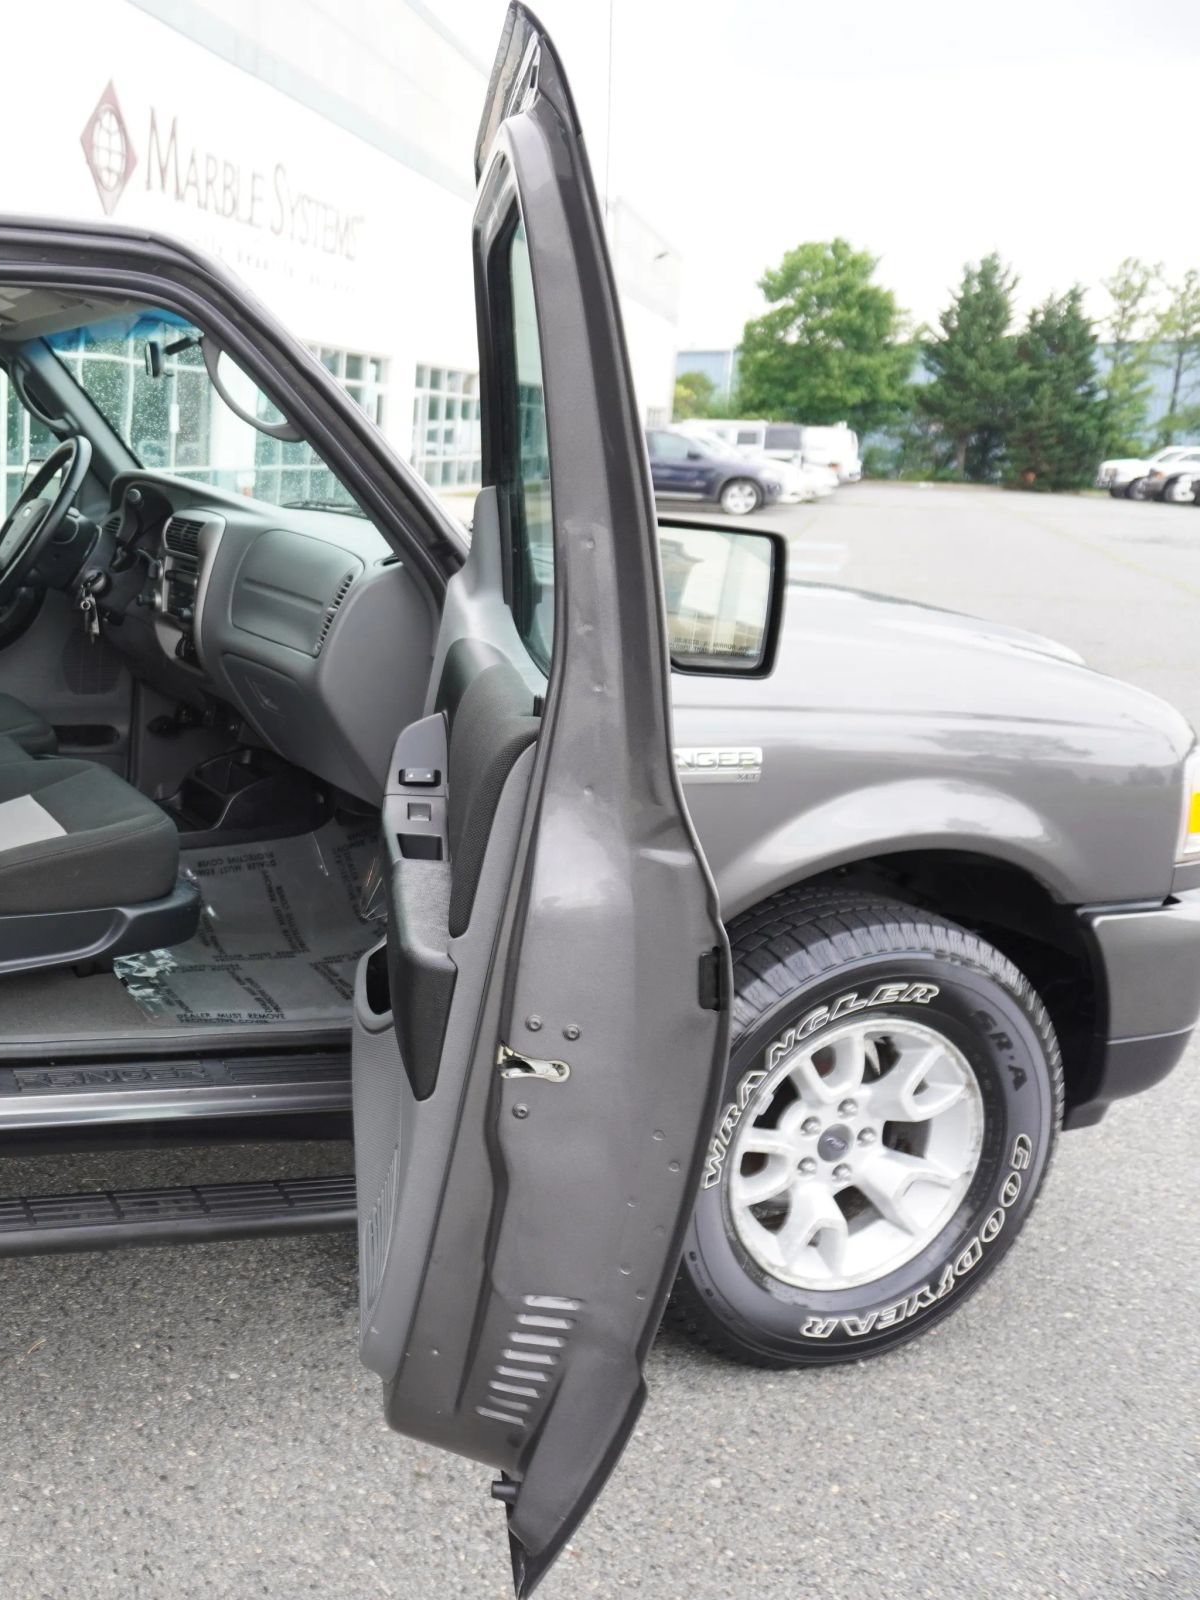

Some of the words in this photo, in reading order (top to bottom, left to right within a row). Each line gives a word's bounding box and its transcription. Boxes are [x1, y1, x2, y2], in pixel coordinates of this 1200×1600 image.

[145, 105, 264, 229] MARBLE
[674, 750, 761, 769] NGER
[704, 983, 940, 1190] WRANGLER
[800, 1133, 1034, 1339] GOODYEAR
